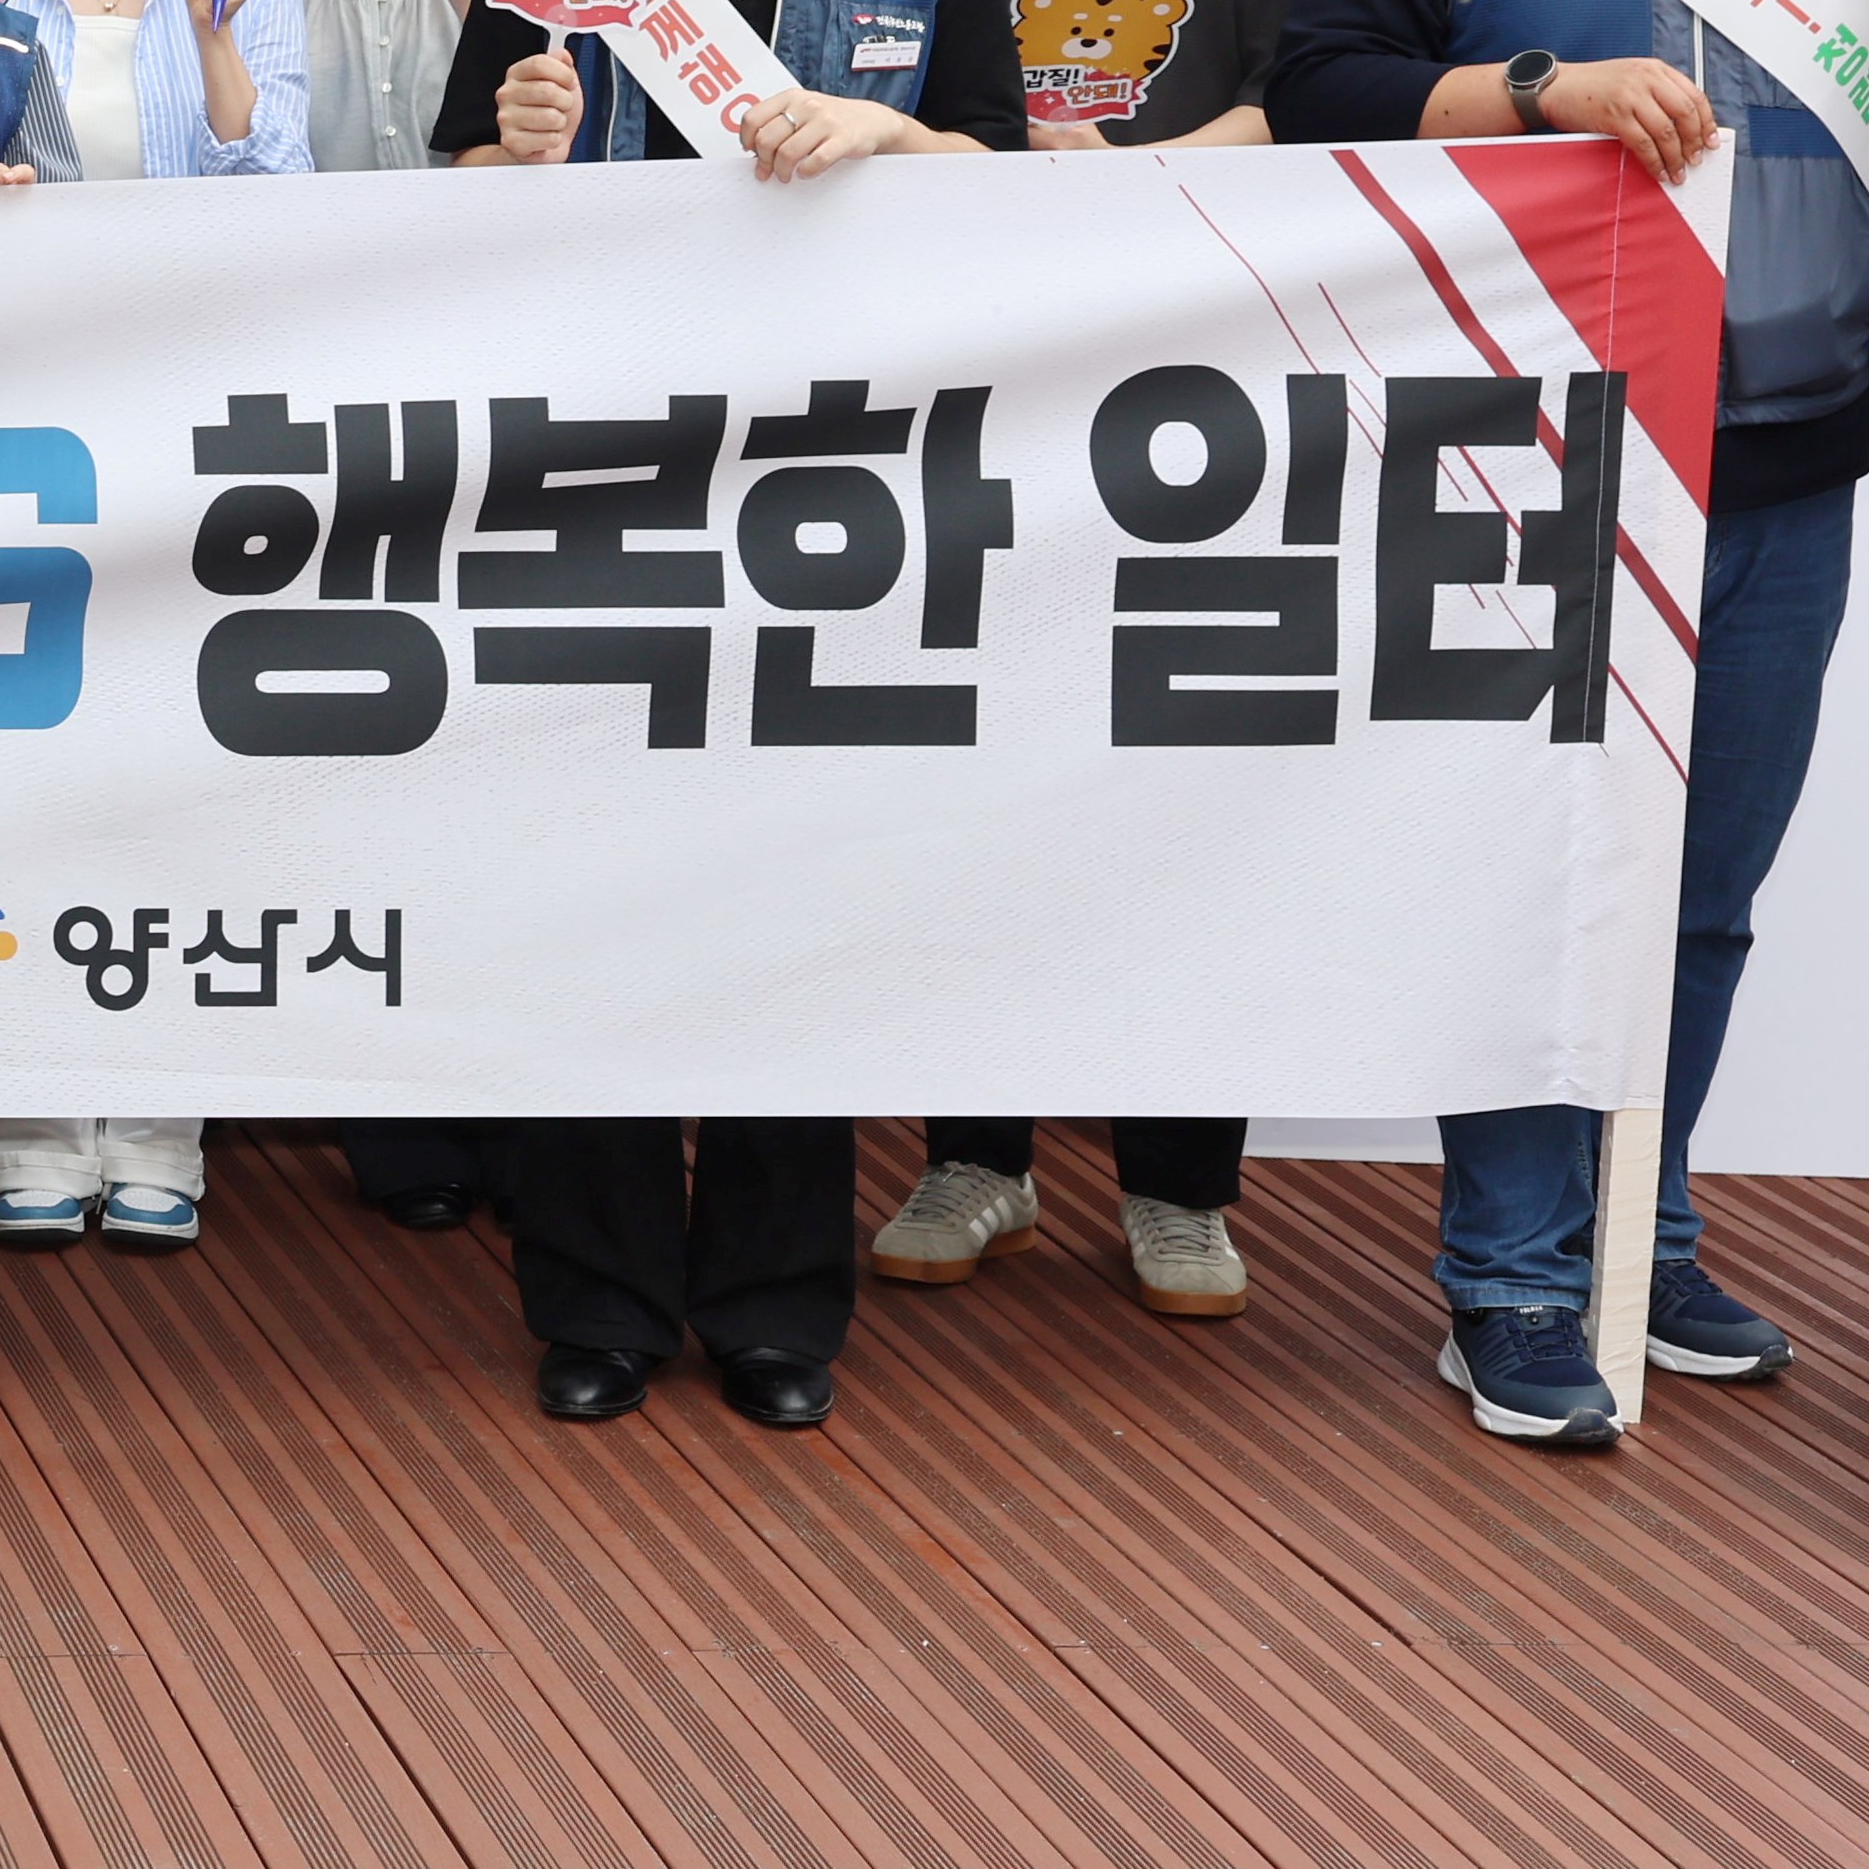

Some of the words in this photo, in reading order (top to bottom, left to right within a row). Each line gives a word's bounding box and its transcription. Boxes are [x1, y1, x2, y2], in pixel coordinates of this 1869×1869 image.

[1024, 69, 1080, 88] 갑질!
[192, 380, 1014, 757] 행복한
[1089, 365, 1627, 747] 일터
[53, 906, 402, 1011] 양산시
